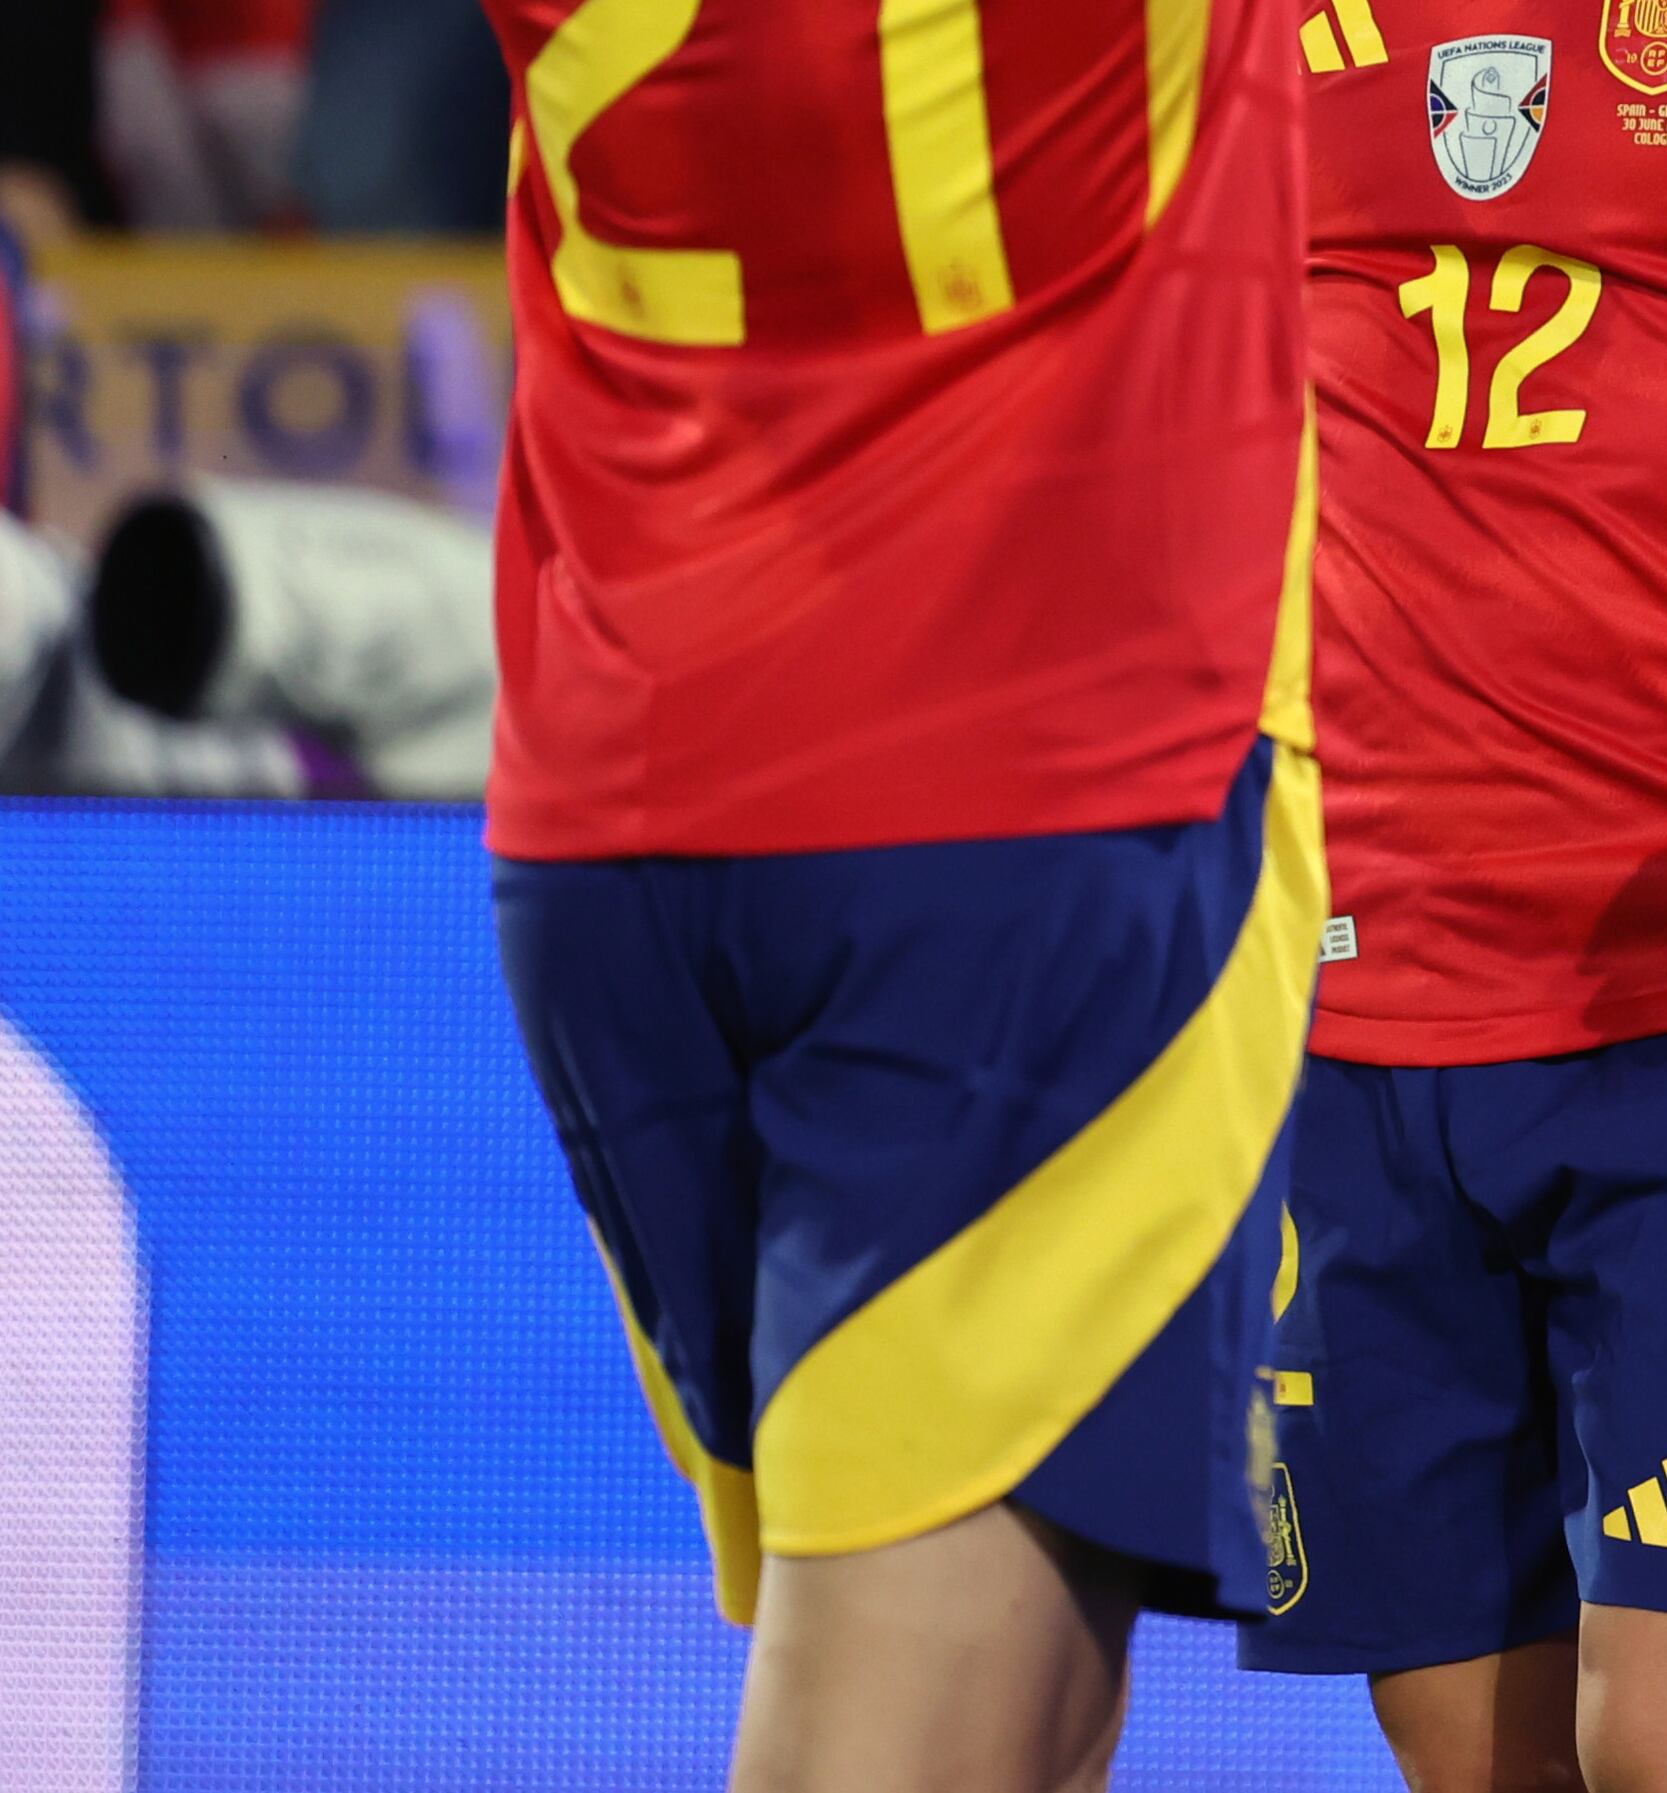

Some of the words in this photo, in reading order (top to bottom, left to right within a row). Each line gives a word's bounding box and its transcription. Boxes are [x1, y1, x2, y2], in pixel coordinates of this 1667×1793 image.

[1438, 46, 1462, 59] UEFA
[1465, 41, 1507, 53] NATIONS
[1509, 41, 1546, 54] LEAGUE
[1617, 103, 1646, 117] SPAIN
[1622, 118, 1636, 130] 30
[1638, 118, 1664, 131] JUNE
[1455, 176, 1489, 193] WINNER
[1492, 172, 1513, 192] 2023
[1398, 244, 1602, 449] 12
